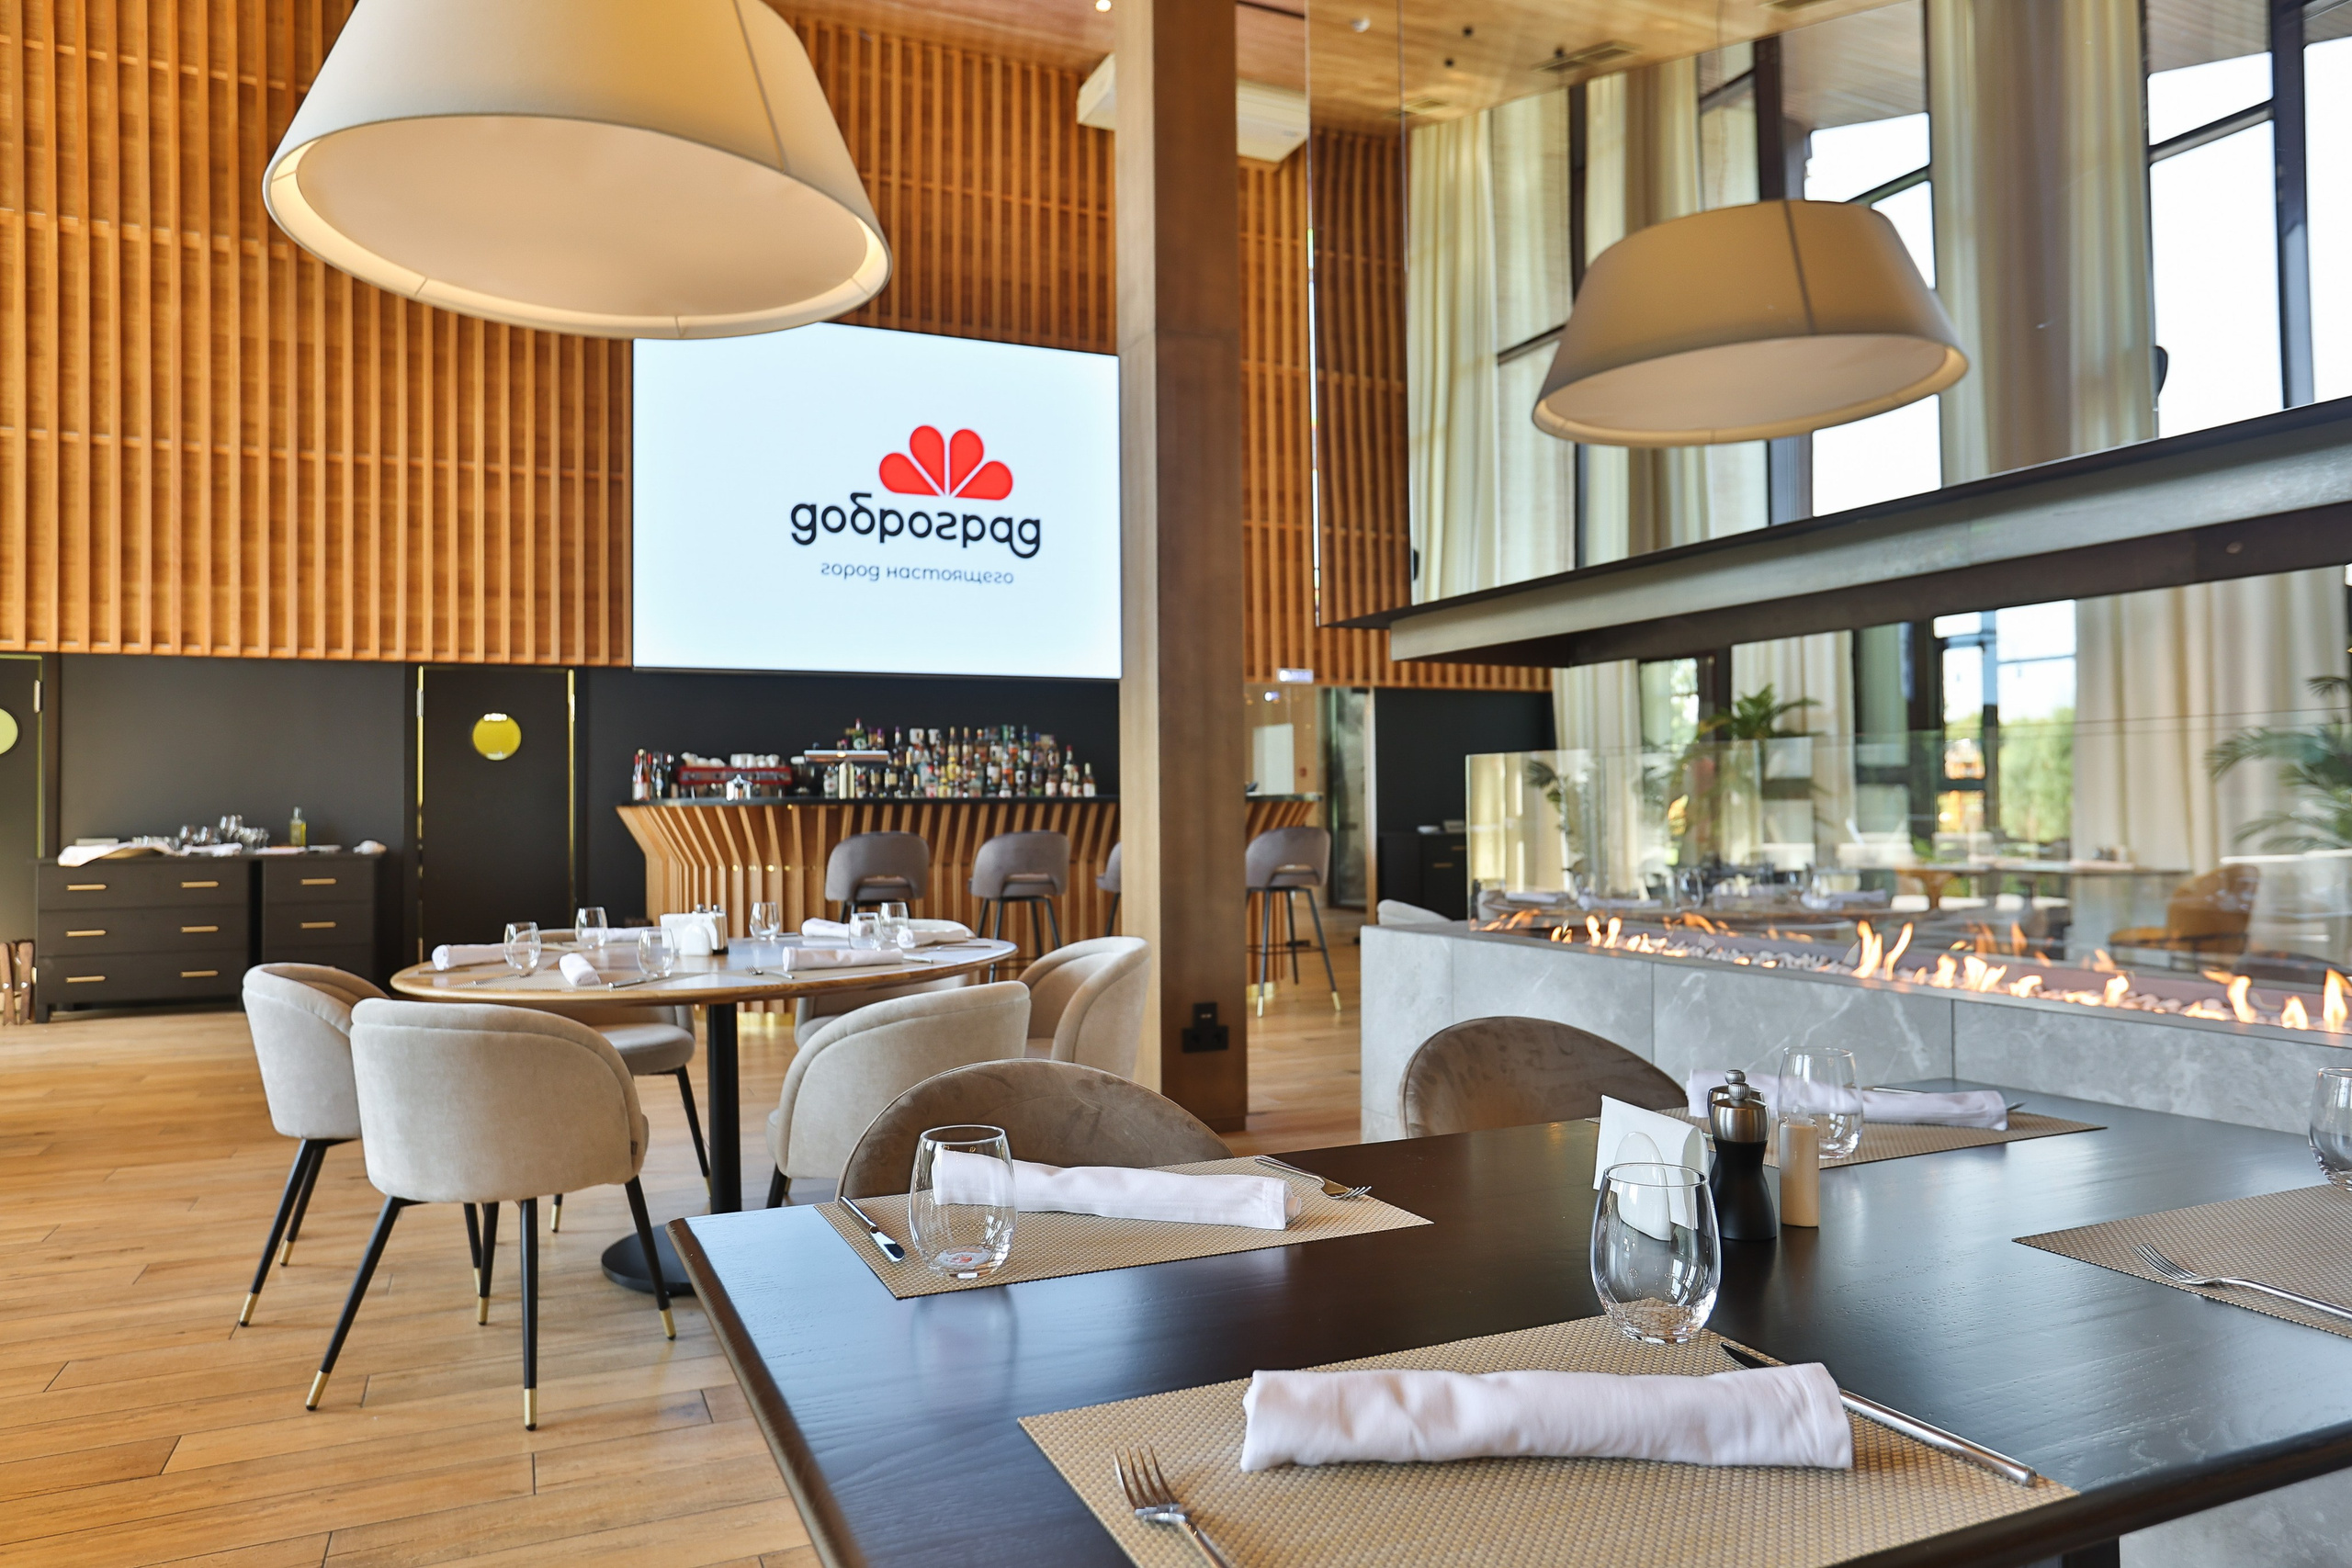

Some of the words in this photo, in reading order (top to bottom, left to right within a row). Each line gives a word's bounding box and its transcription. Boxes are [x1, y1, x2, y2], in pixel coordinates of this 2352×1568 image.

[791, 491, 1041, 558] доброград
[821, 563, 879, 581] город
[887, 566, 1013, 584] настоящего
